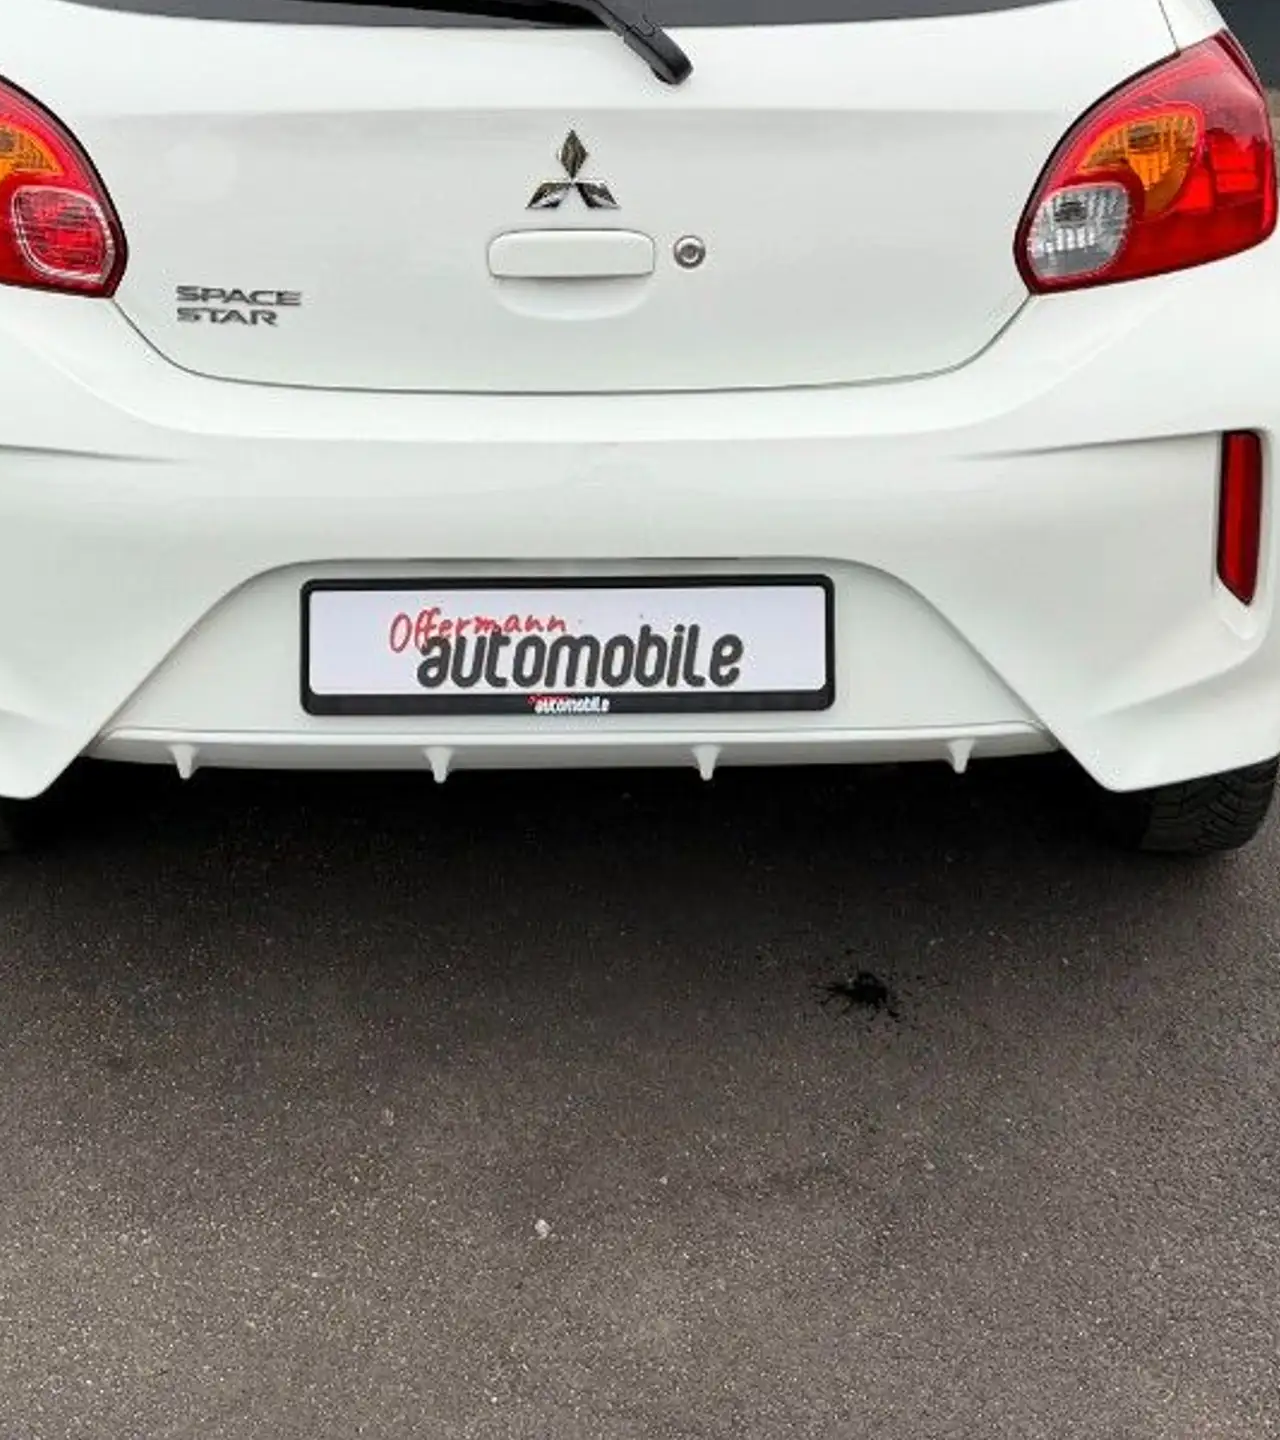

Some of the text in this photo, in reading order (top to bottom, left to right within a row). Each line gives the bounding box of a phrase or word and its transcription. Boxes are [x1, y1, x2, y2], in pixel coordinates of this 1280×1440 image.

[176, 285, 301, 306] SPACE
[176, 307, 278, 327] STAR
[390, 607, 567, 653] Offermann
[417, 623, 743, 689] automobile
